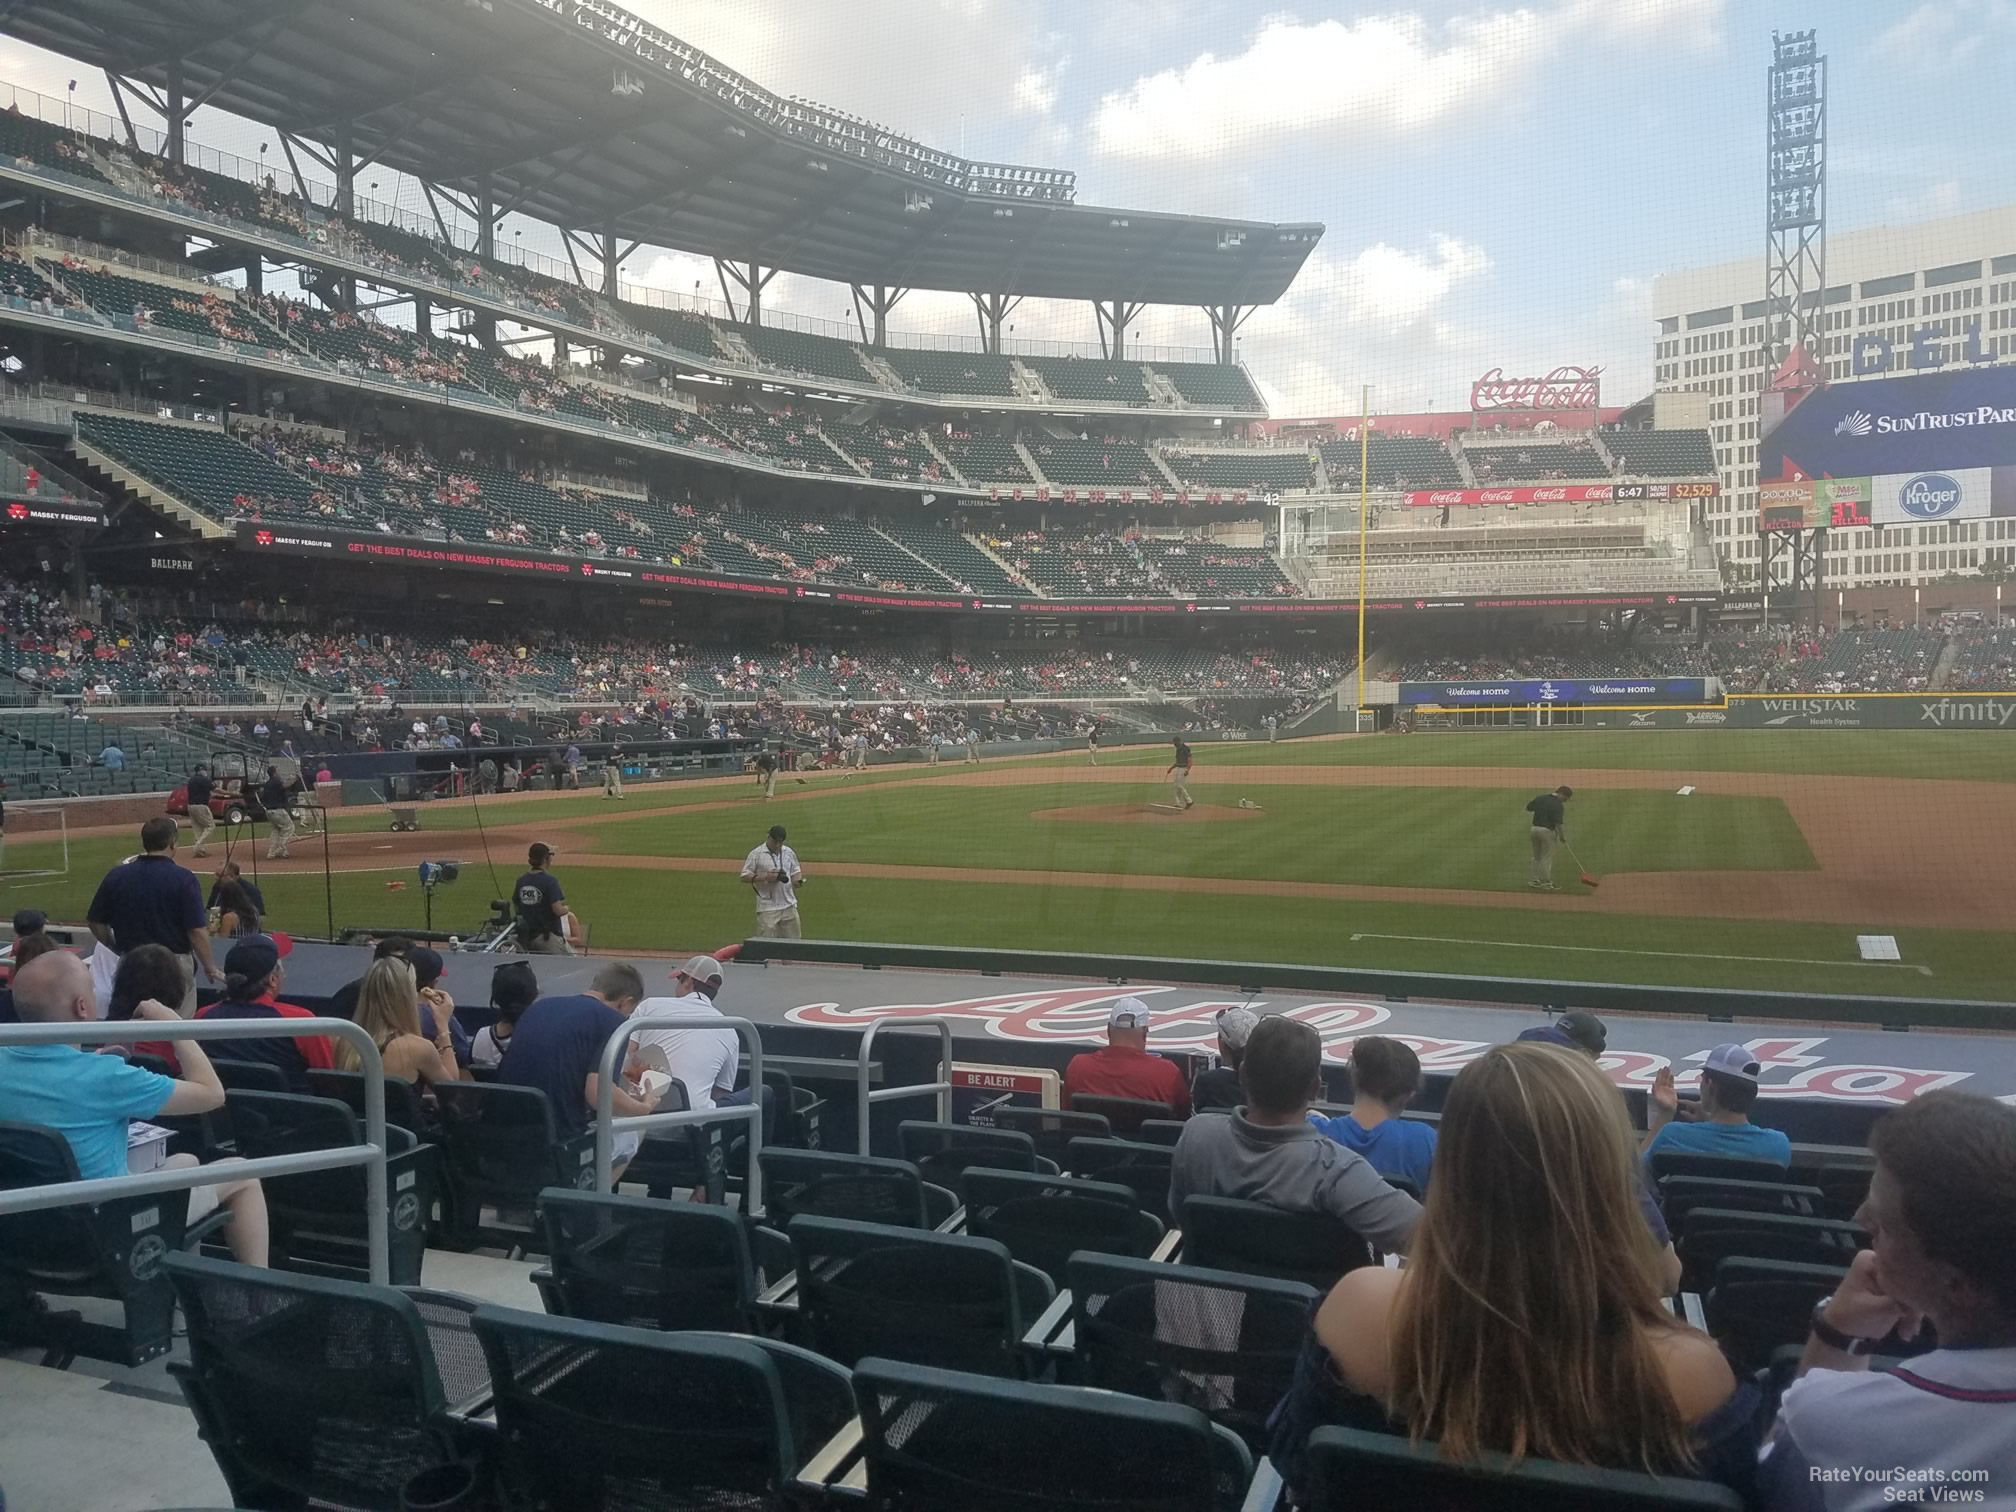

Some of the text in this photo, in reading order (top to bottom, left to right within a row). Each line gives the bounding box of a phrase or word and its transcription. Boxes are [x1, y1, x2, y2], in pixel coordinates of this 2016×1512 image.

[1013, 488, 1022, 501] 6
[1618, 487, 1642, 498] 6:47
[1676, 483, 1713, 498] $2,529
[1762, 489, 1802, 498] POWER
[1906, 481, 1957, 513] Kroger
[1263, 493, 1280, 506] 42
[30, 510, 97, 523] MASSEY FERGUSON
[1831, 501, 1857, 519] 37
[1831, 516, 1869, 526] MILLION
[275, 536, 300, 545] MASSEY
[347, 543, 570, 572] GET THE BEST DEALS ON NEW MASSEY FERGUSON TRACTORS
[151, 558, 193, 571] BALLPARK
[641, 572, 653, 581] GET
[654, 574, 665, 582] THE
[665, 575, 679, 583] BEST
[1446, 687, 1481, 697] Welcome
[1589, 685, 1626, 695] Welcome
[1762, 699, 1857, 714] WELLSTAR
[1920, 698, 2016, 726] xfinity
[1809, 717, 1860, 727] Health System
[522, 890, 536, 898] FOX
[967, 1074, 1016, 1088] BE ALERT
